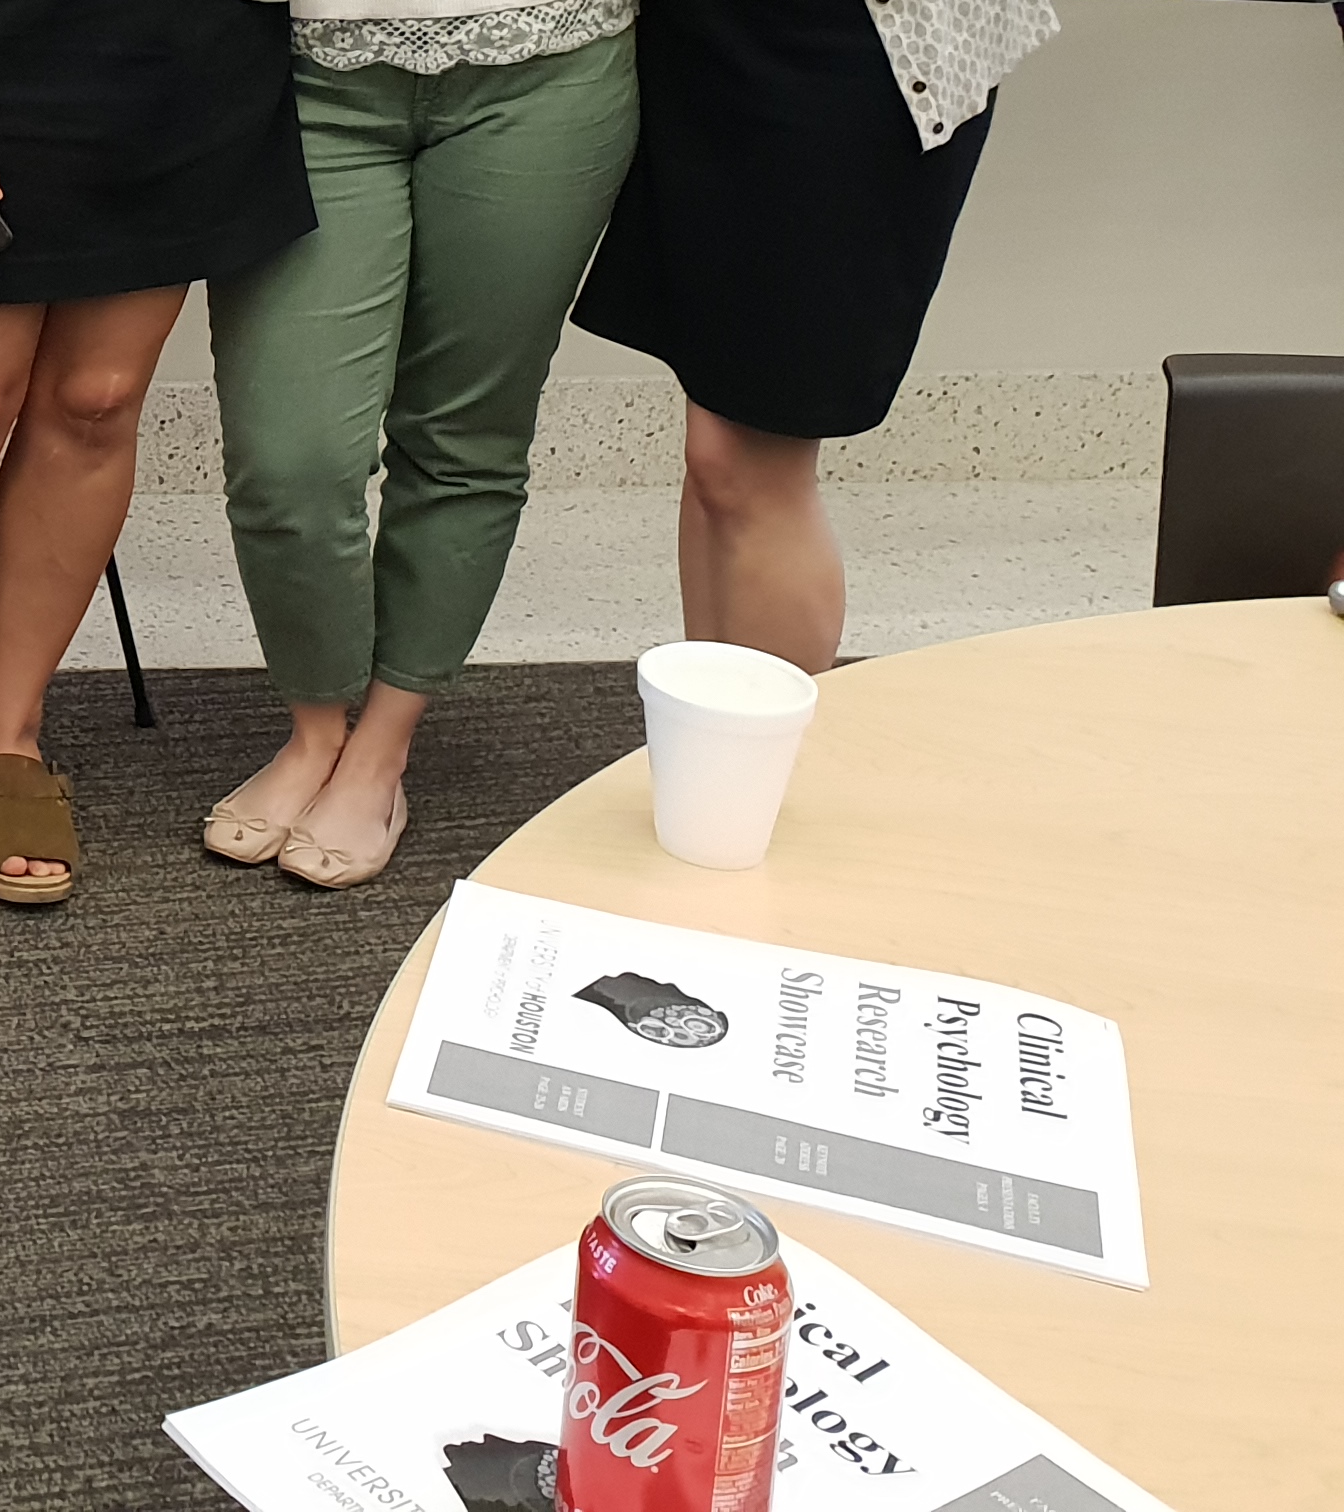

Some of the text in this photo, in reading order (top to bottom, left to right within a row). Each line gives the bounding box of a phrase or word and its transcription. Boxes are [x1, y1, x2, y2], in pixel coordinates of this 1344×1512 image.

[509, 992, 547, 1054] HOUSTON
[771, 967, 824, 1084] Showcase
[854, 981, 902, 1099] Research
[922, 995, 983, 1145] Psychology
[1017, 1012, 1068, 1119] Clinical
[588, 1234, 617, 1274] TASTE
